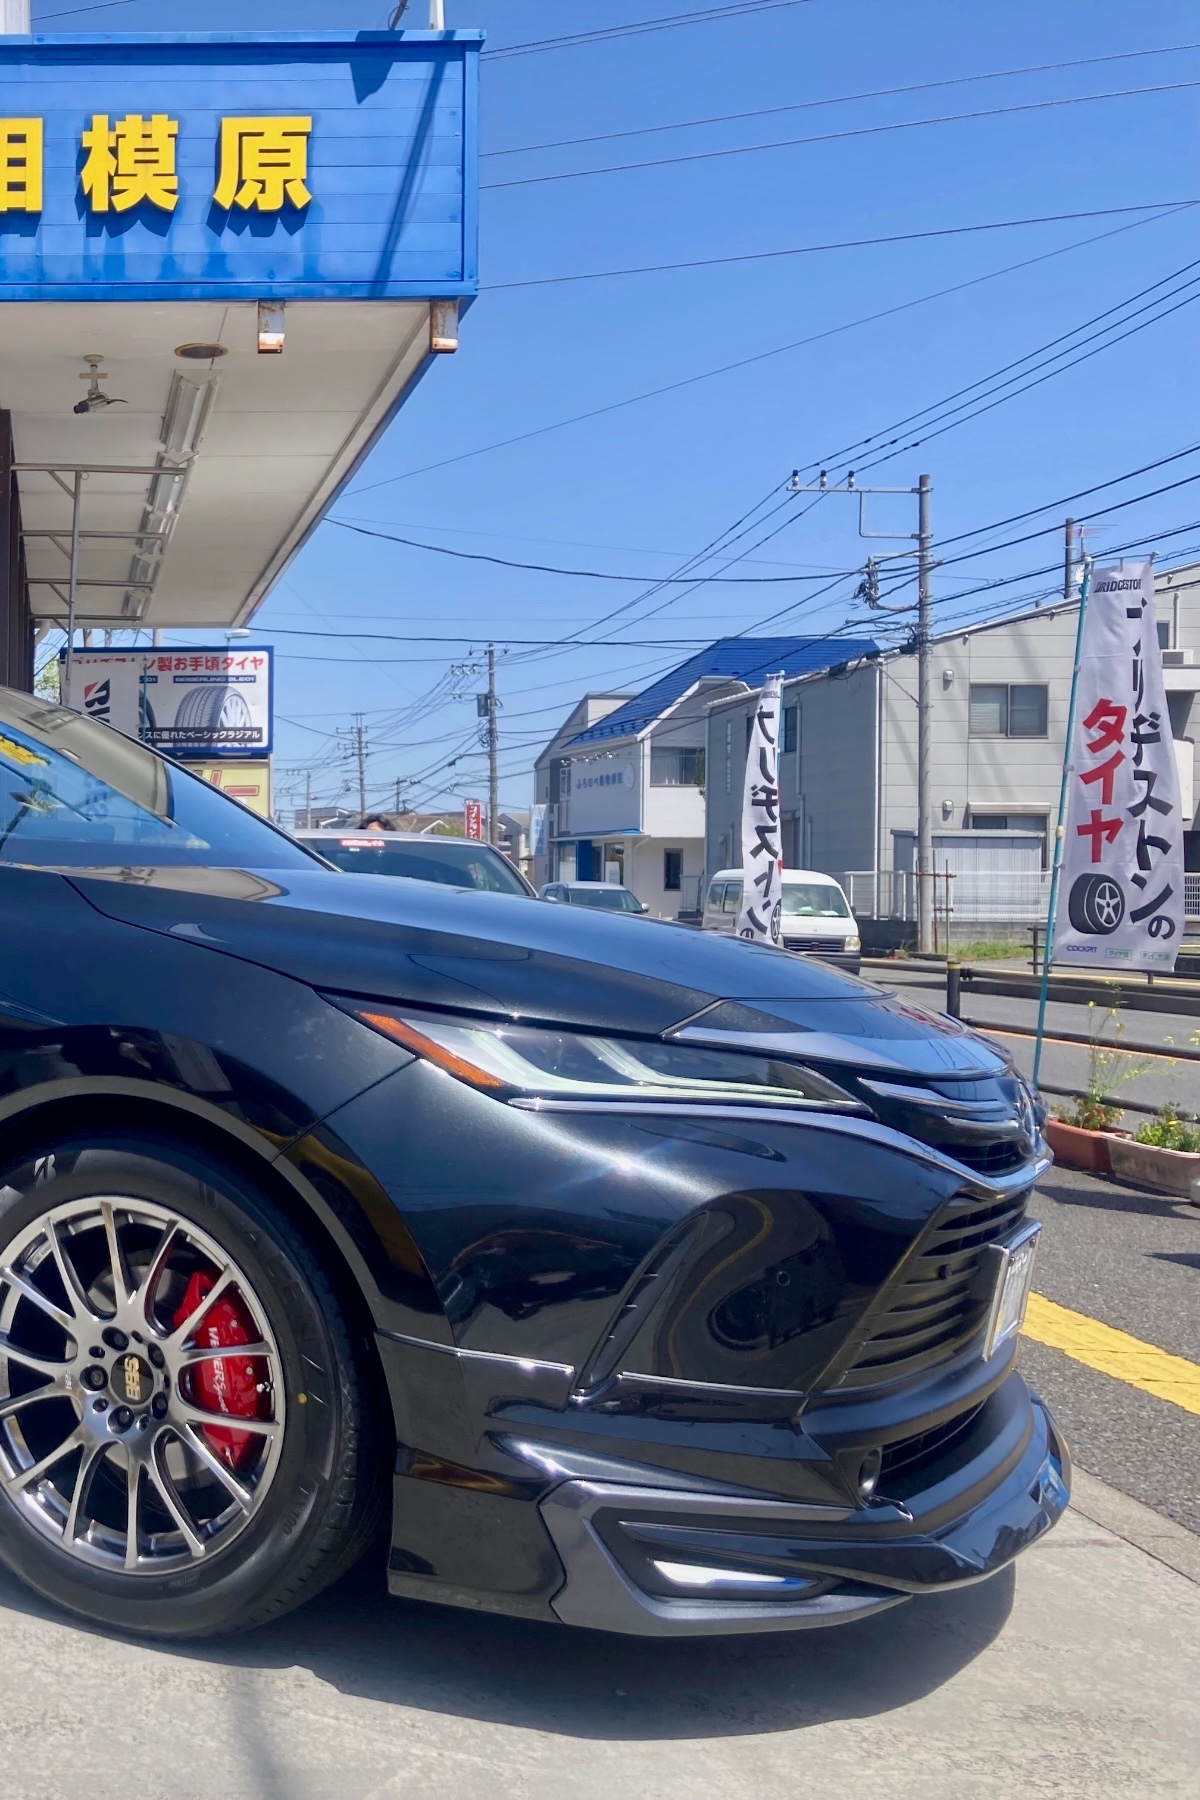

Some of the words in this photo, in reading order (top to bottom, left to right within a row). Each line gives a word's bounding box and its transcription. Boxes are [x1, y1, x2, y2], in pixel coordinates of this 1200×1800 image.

[1077, 698, 1128, 863] タイヤ
[125, 1356, 141, 1400] BBS
[208, 1326, 225, 1380] WEER
